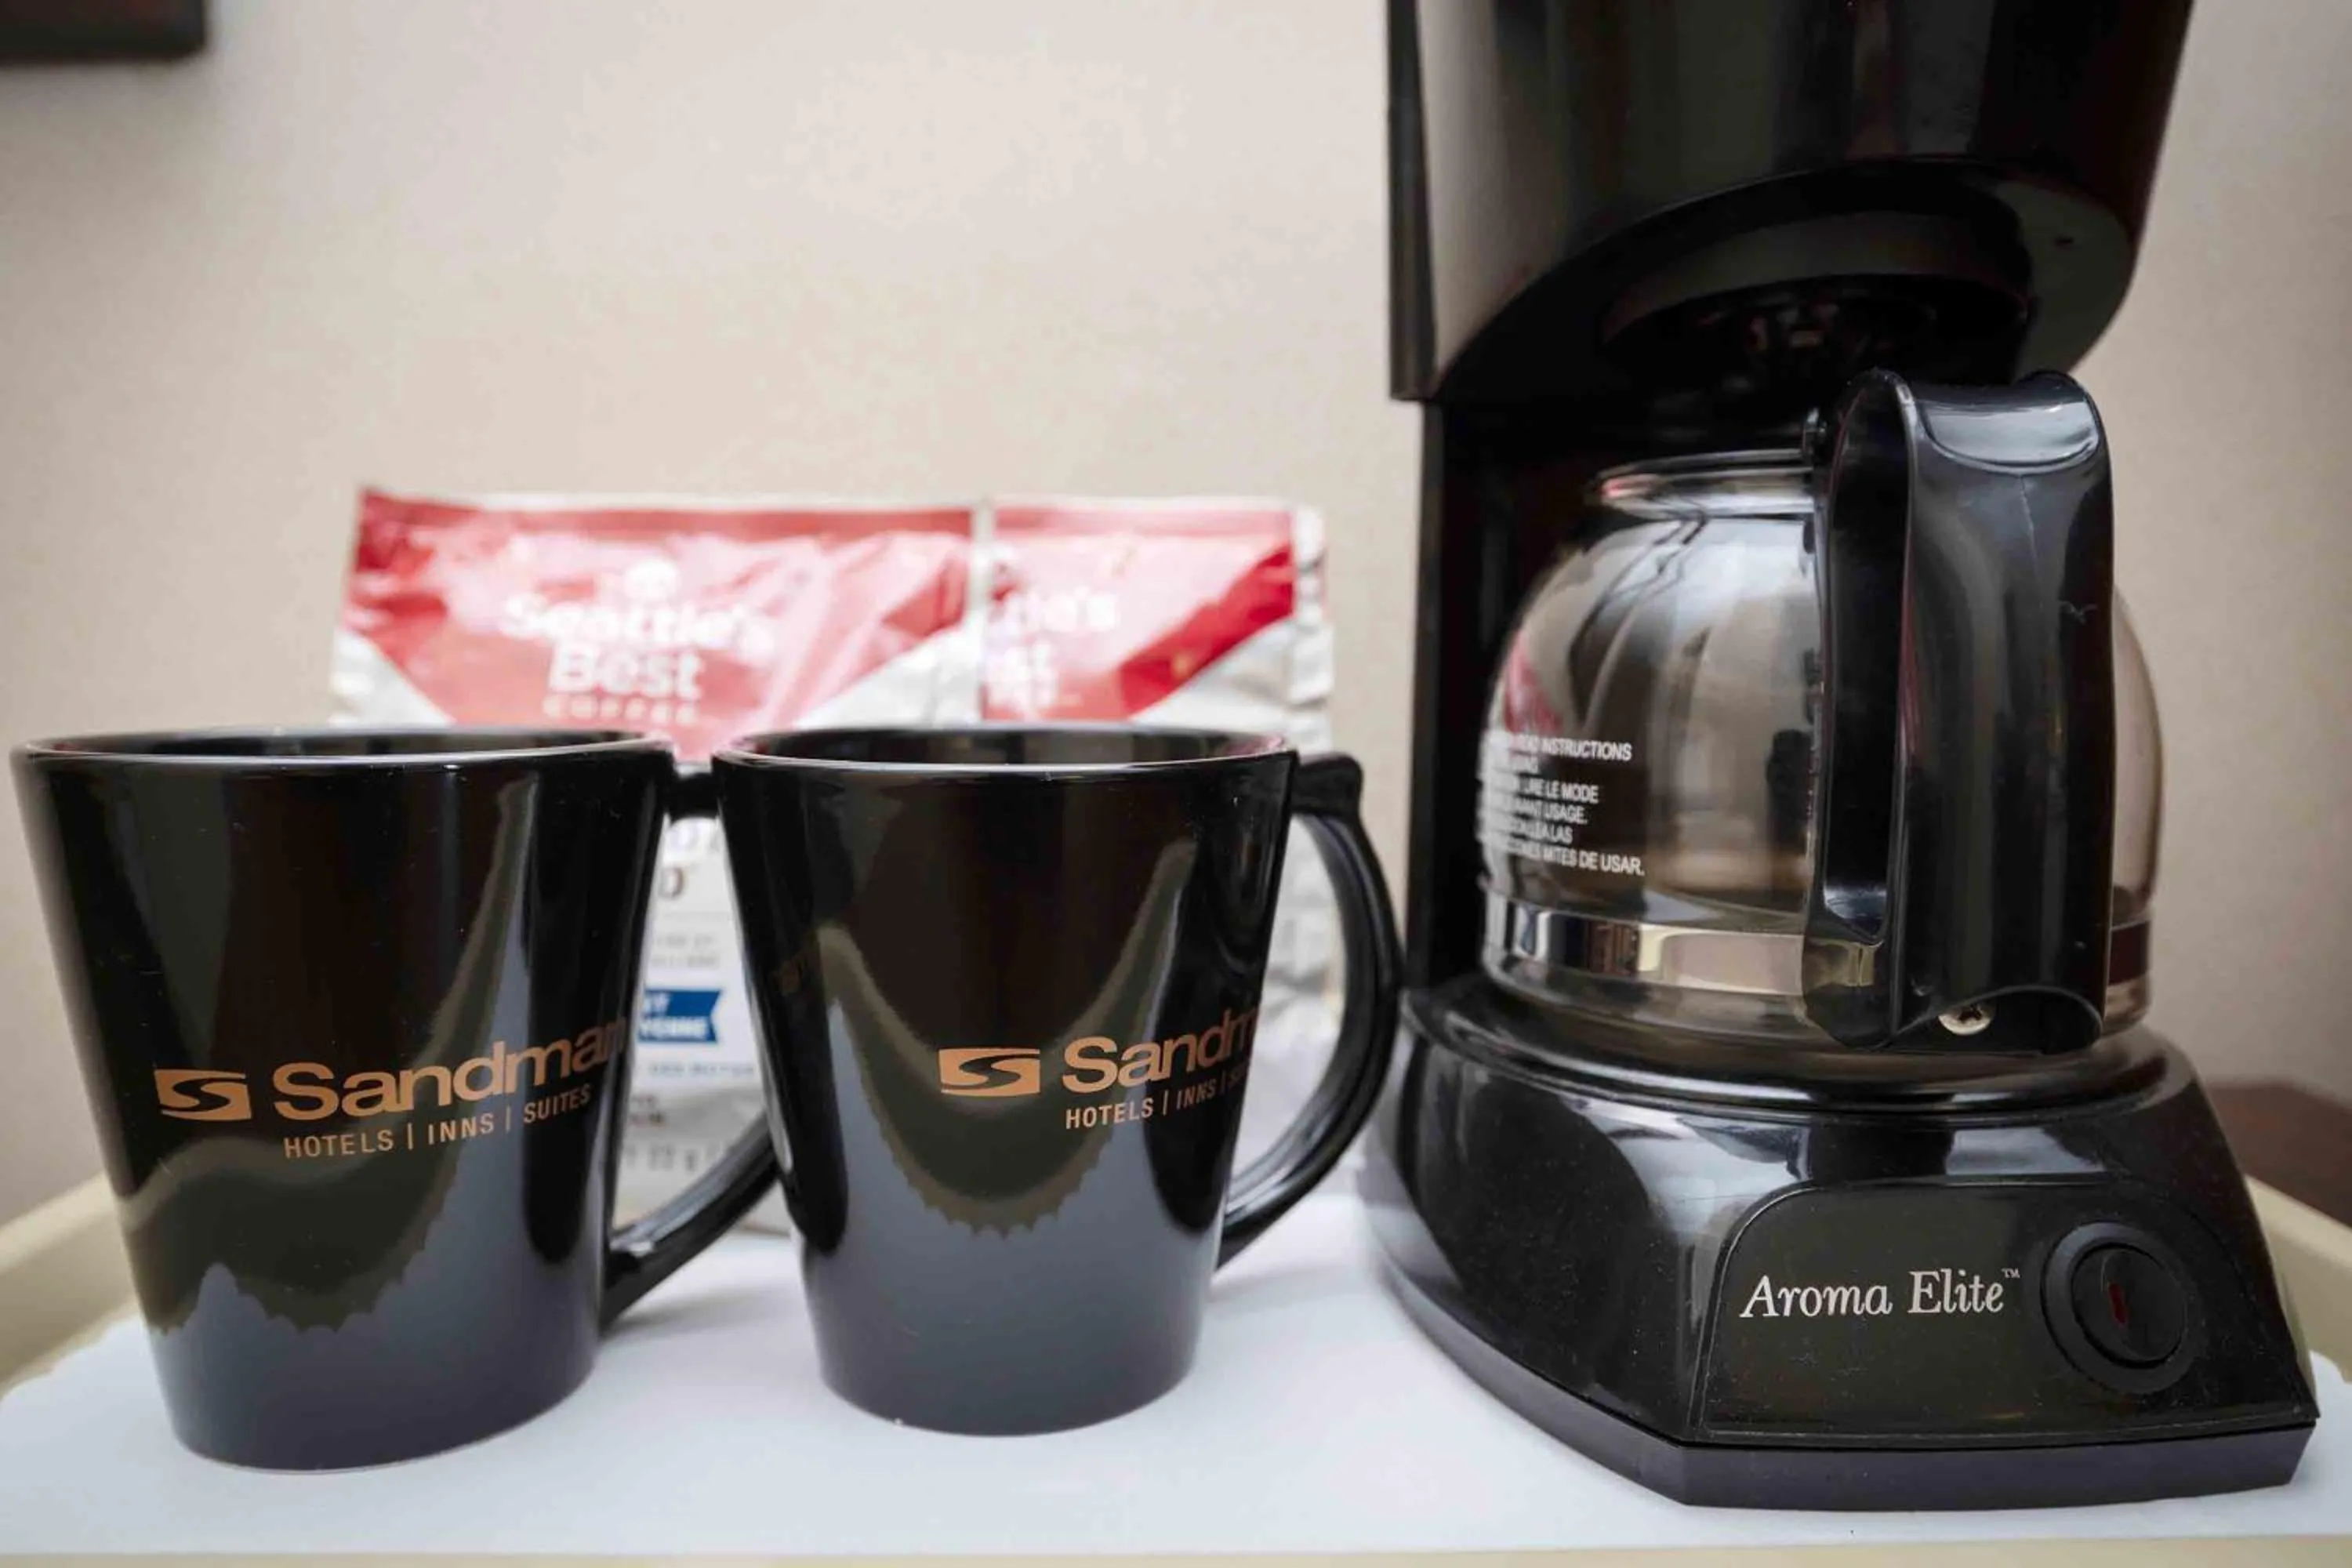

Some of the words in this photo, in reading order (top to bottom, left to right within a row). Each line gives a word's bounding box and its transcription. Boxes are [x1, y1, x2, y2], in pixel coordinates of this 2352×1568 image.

[550, 641, 701, 699] Best
[1561, 782, 1599, 804] MODE
[1578, 849, 1599, 871] DE
[284, 1127, 394, 1159] HOTELS
[428, 1112, 494, 1145] INNS
[524, 1083, 591, 1123] SUITES
[1065, 1097, 1154, 1130] HOTELS
[1176, 1078, 1217, 1110] INNS
[1739, 1275, 1893, 1319] Aroma
